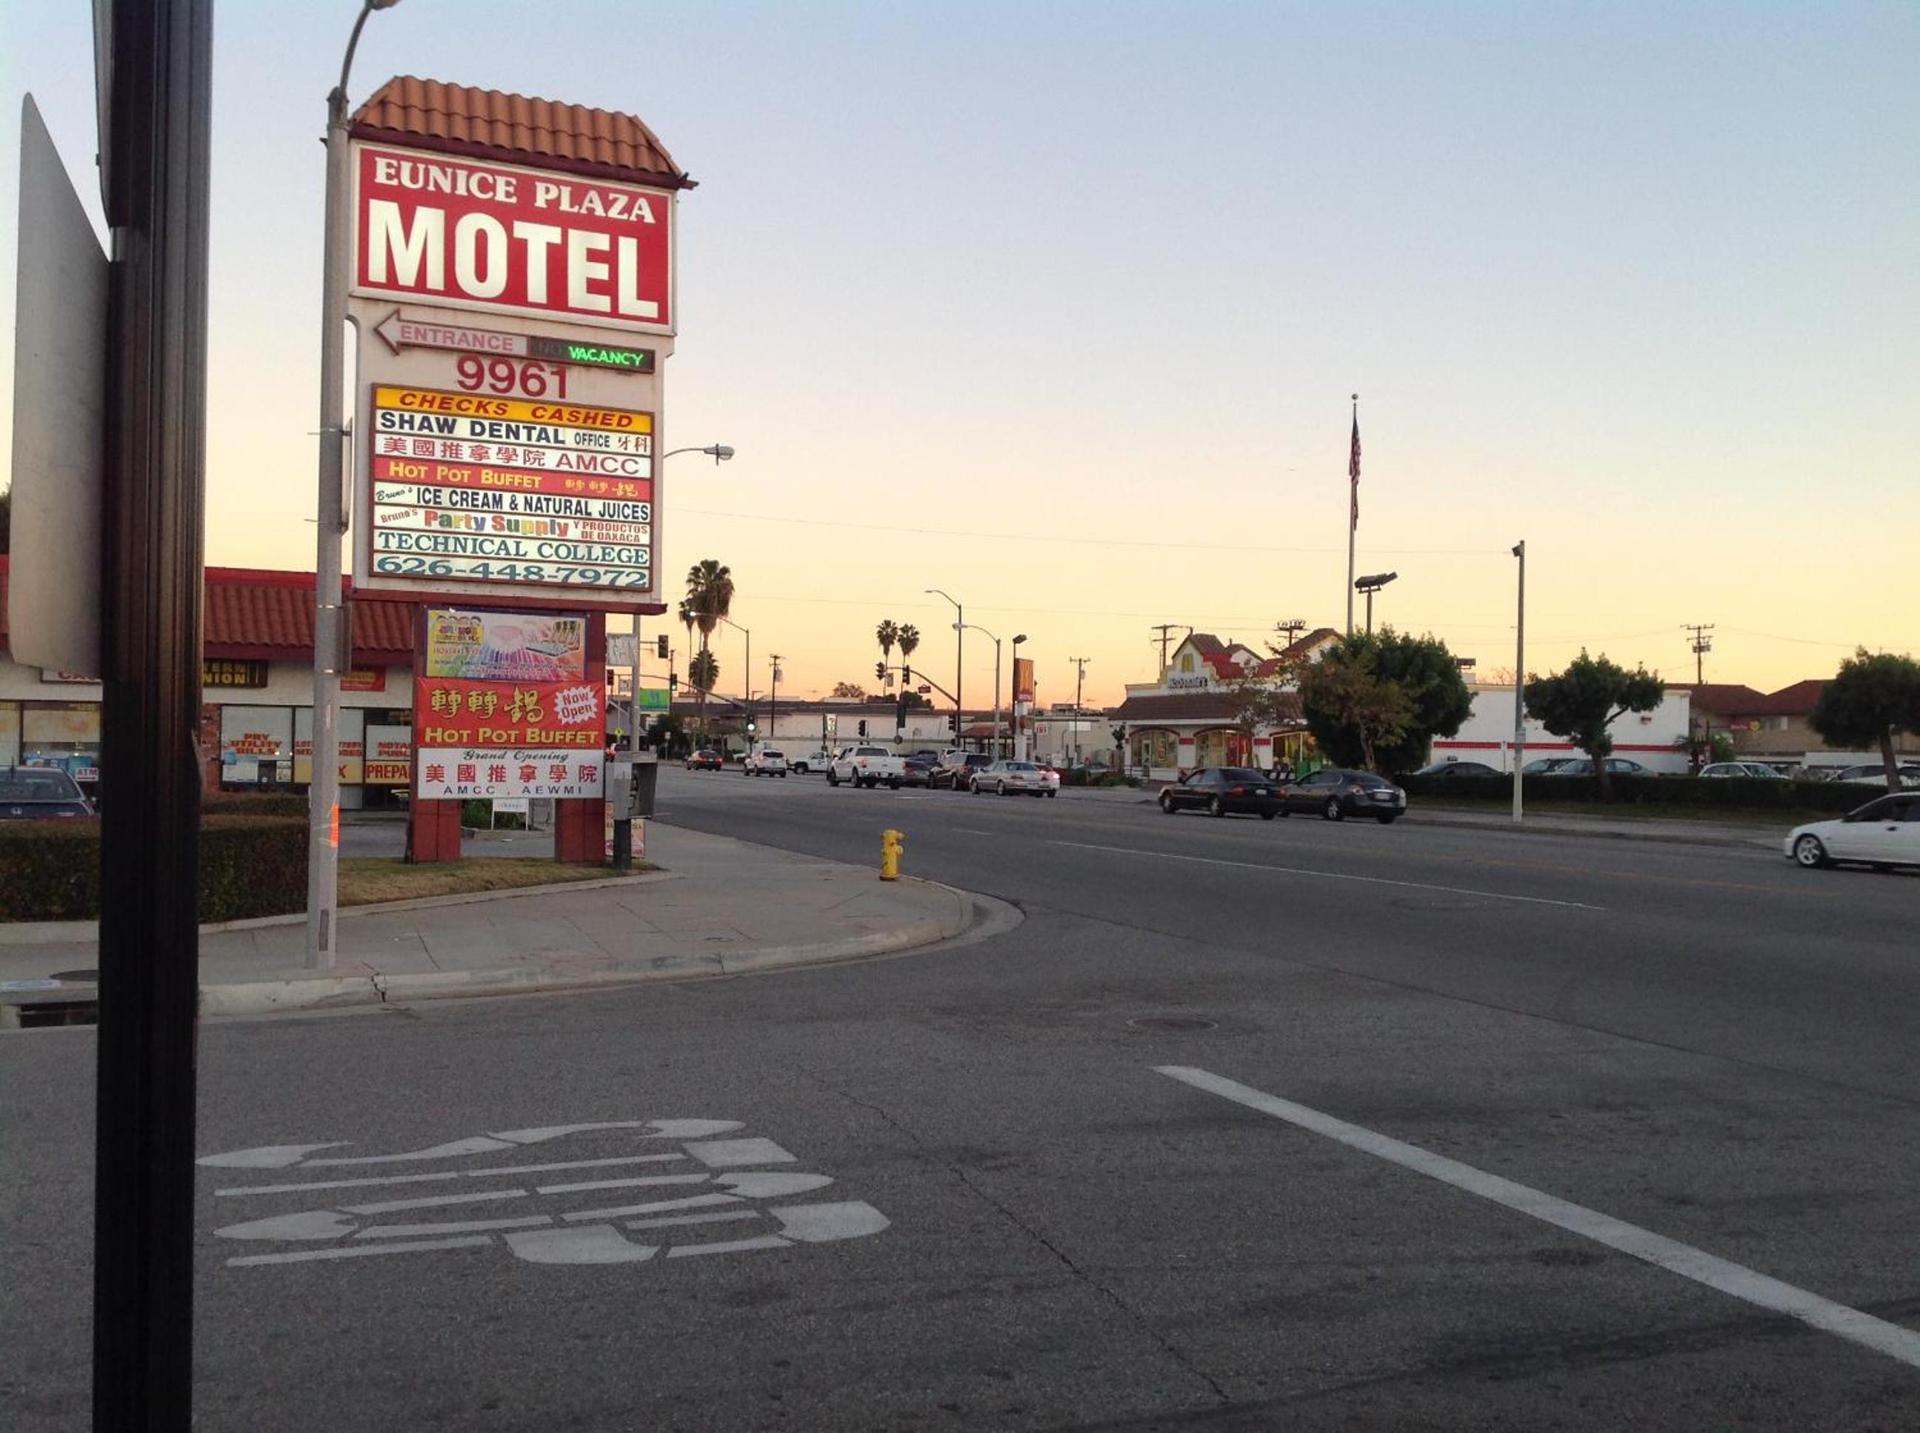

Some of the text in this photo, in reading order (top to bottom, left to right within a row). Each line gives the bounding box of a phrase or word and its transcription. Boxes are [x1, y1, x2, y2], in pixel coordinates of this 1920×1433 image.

[374, 157, 656, 224] EUNICE PLAZA
[368, 198, 659, 319] MOTEL
[400, 325, 513, 351] ENTRANCE
[568, 345, 644, 366] VACANCY
[457, 356, 567, 399] 9961
[400, 393, 633, 428] CHECKS CASHED
[380, 411, 648, 453] SHAW DENTAL OFFICE 牙科
[555, 453, 640, 475] AMCC
[389, 461, 429, 479] HOT
[436, 467, 472, 483] POT
[481, 469, 543, 490] BUFFET
[417, 487, 443, 506] ICE
[450, 489, 504, 510] CREAM
[509, 494, 519, 511] &
[523, 495, 592, 517] NATURAL
[598, 501, 650, 521] JUICES
[424, 510, 486, 533] Party
[491, 515, 569, 538] Supply
[573, 520, 648, 535] Y PRODUCTOS
[581, 531, 641, 543] DE OAXACA
[378, 532, 649, 565] TECHNICAL COLLEGE
[377, 555, 647, 588] 626-448-7972
[203, 673, 246, 684] NION
[562, 691, 590, 705] Now
[561, 704, 592, 720] Open
[425, 727, 599, 744] HOT POT BUFFET
[463, 750, 569, 762] Grand Opening
[77, 768, 97, 776] ATM
[366, 764, 409, 780] PREPA
[425, 763, 598, 783] 美國推拿學院
[444, 785, 496, 795] AMCC
[522, 785, 582, 795] AEWMI
